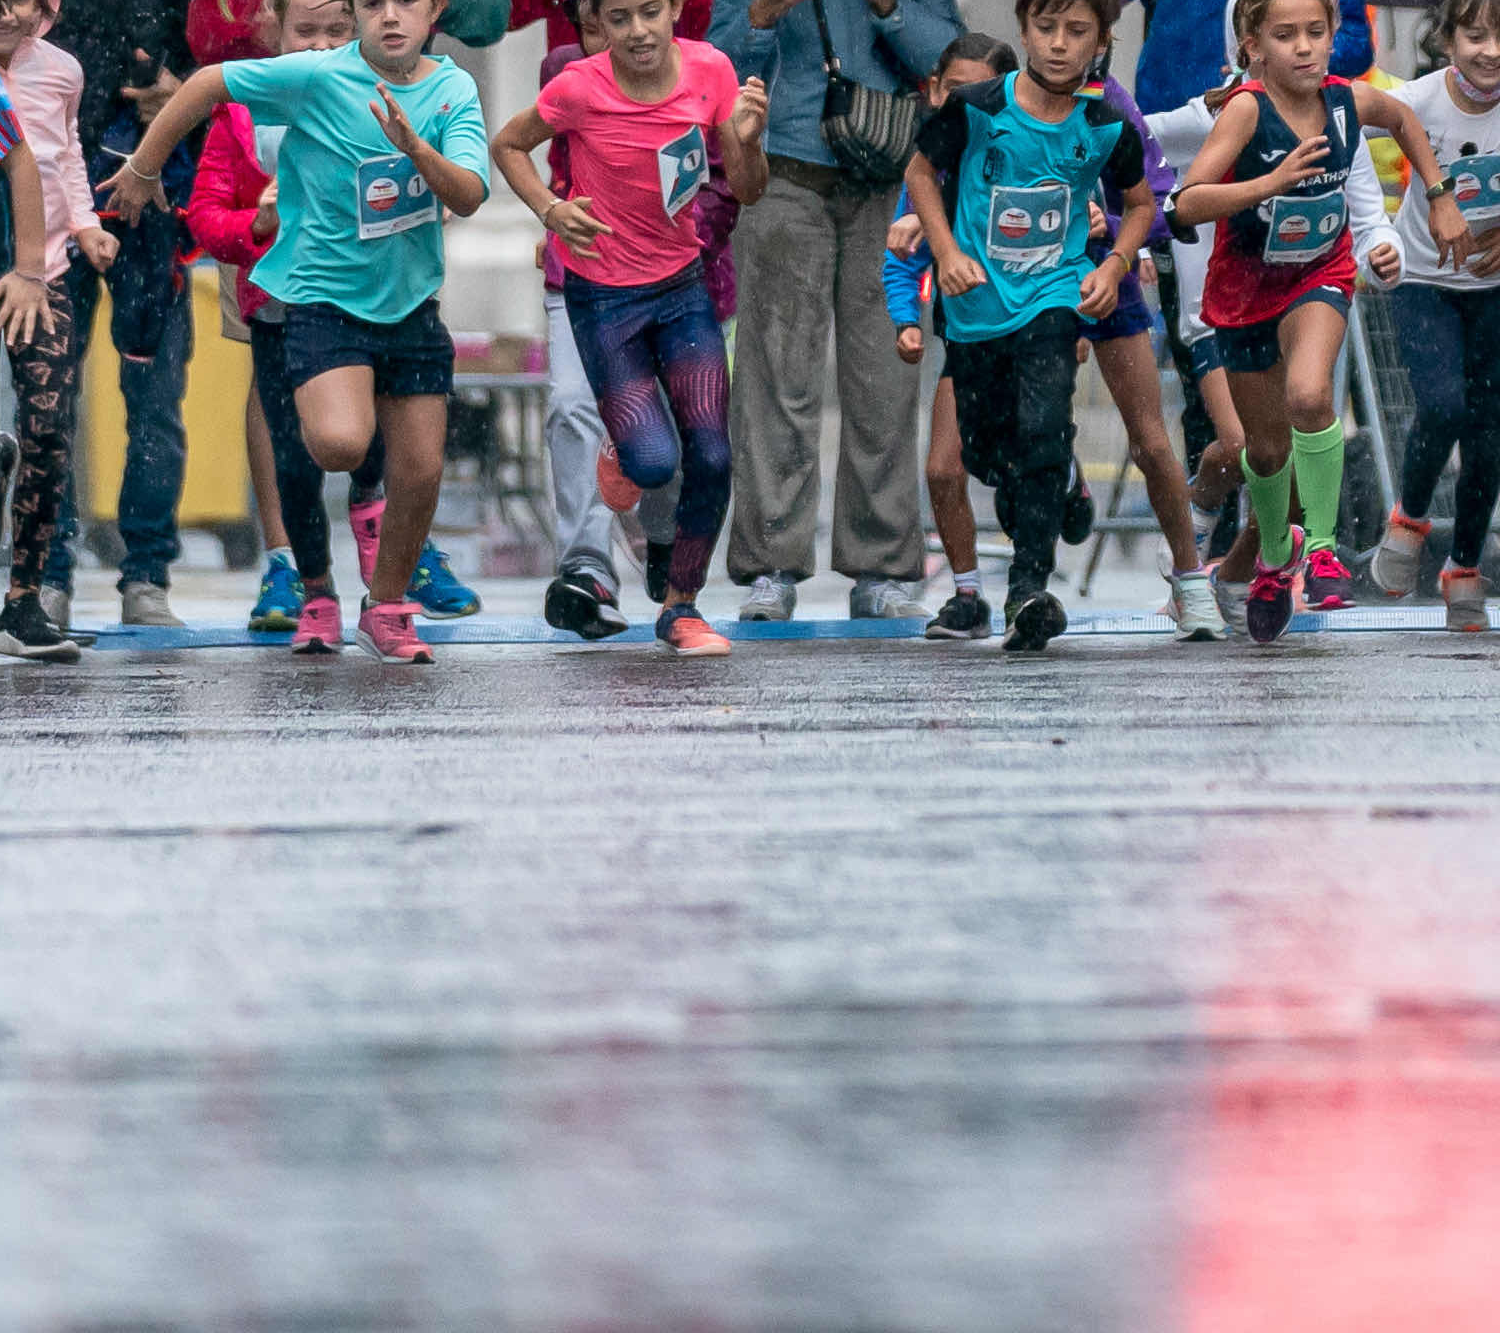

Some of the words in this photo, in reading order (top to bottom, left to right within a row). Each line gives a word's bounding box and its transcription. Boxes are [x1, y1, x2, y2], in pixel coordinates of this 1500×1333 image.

[688, 152, 697, 168] 1
[414, 175, 421, 194] 1
[1297, 166, 1351, 188] ARATHON
[1045, 211, 1052, 228] 1
[1323, 215, 1332, 232] 1
